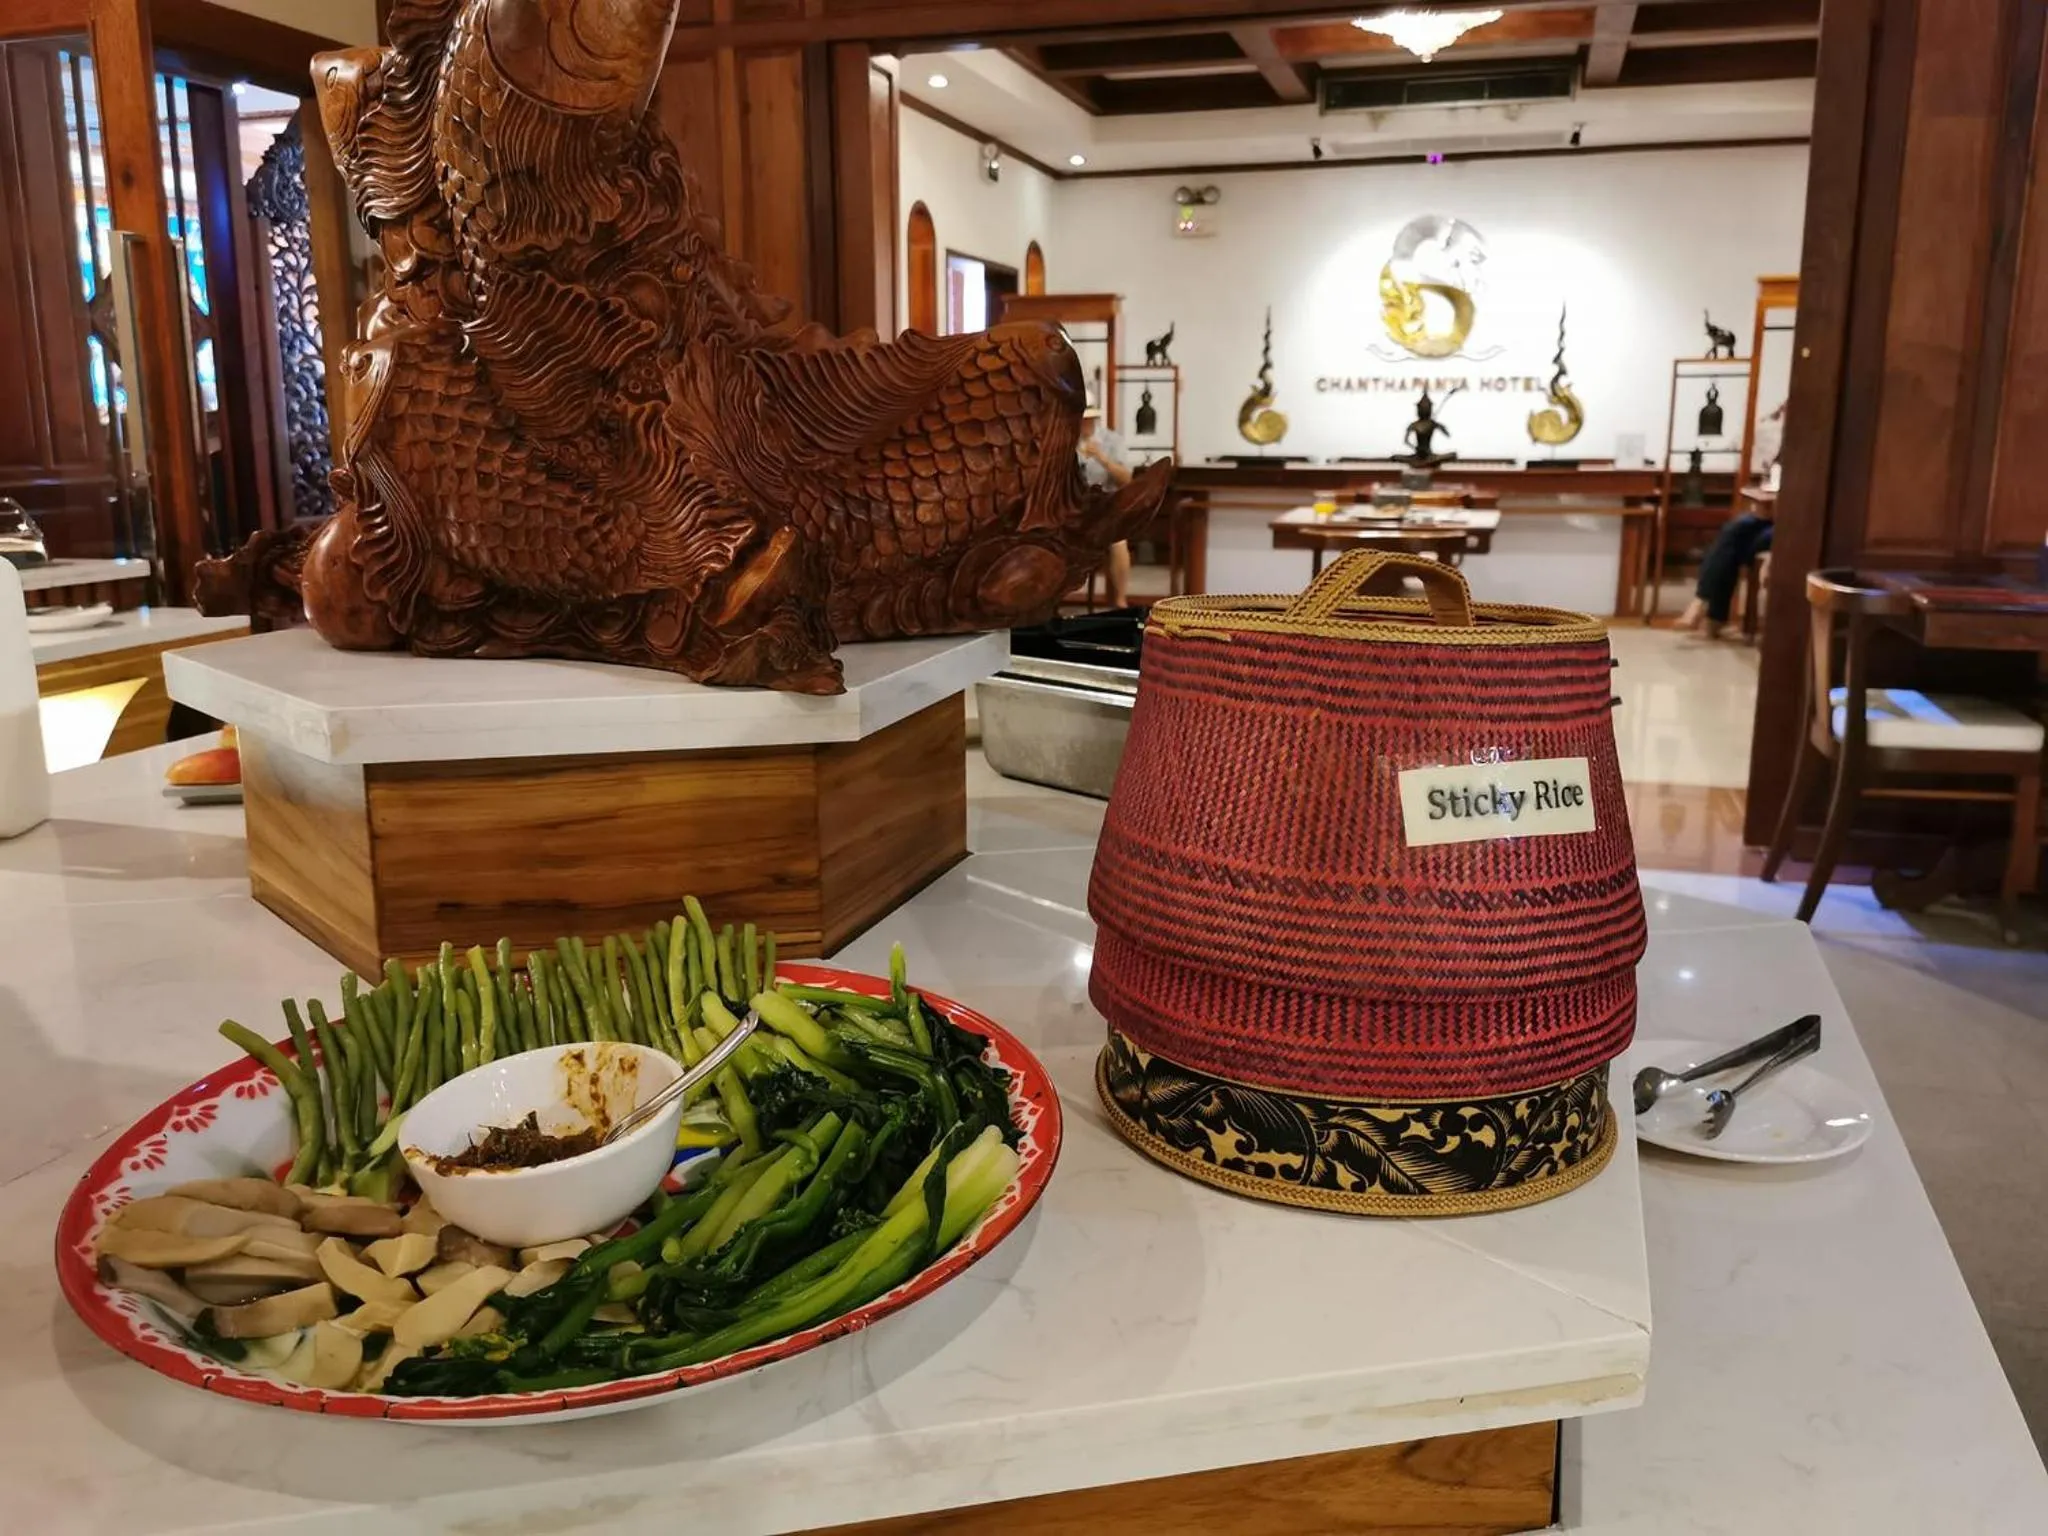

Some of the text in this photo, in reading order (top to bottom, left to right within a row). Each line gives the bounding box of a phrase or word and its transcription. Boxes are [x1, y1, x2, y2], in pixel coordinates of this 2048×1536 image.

[1479, 376, 1547, 393] HOTEL
[1427, 779, 1584, 822] Sticky Rice
